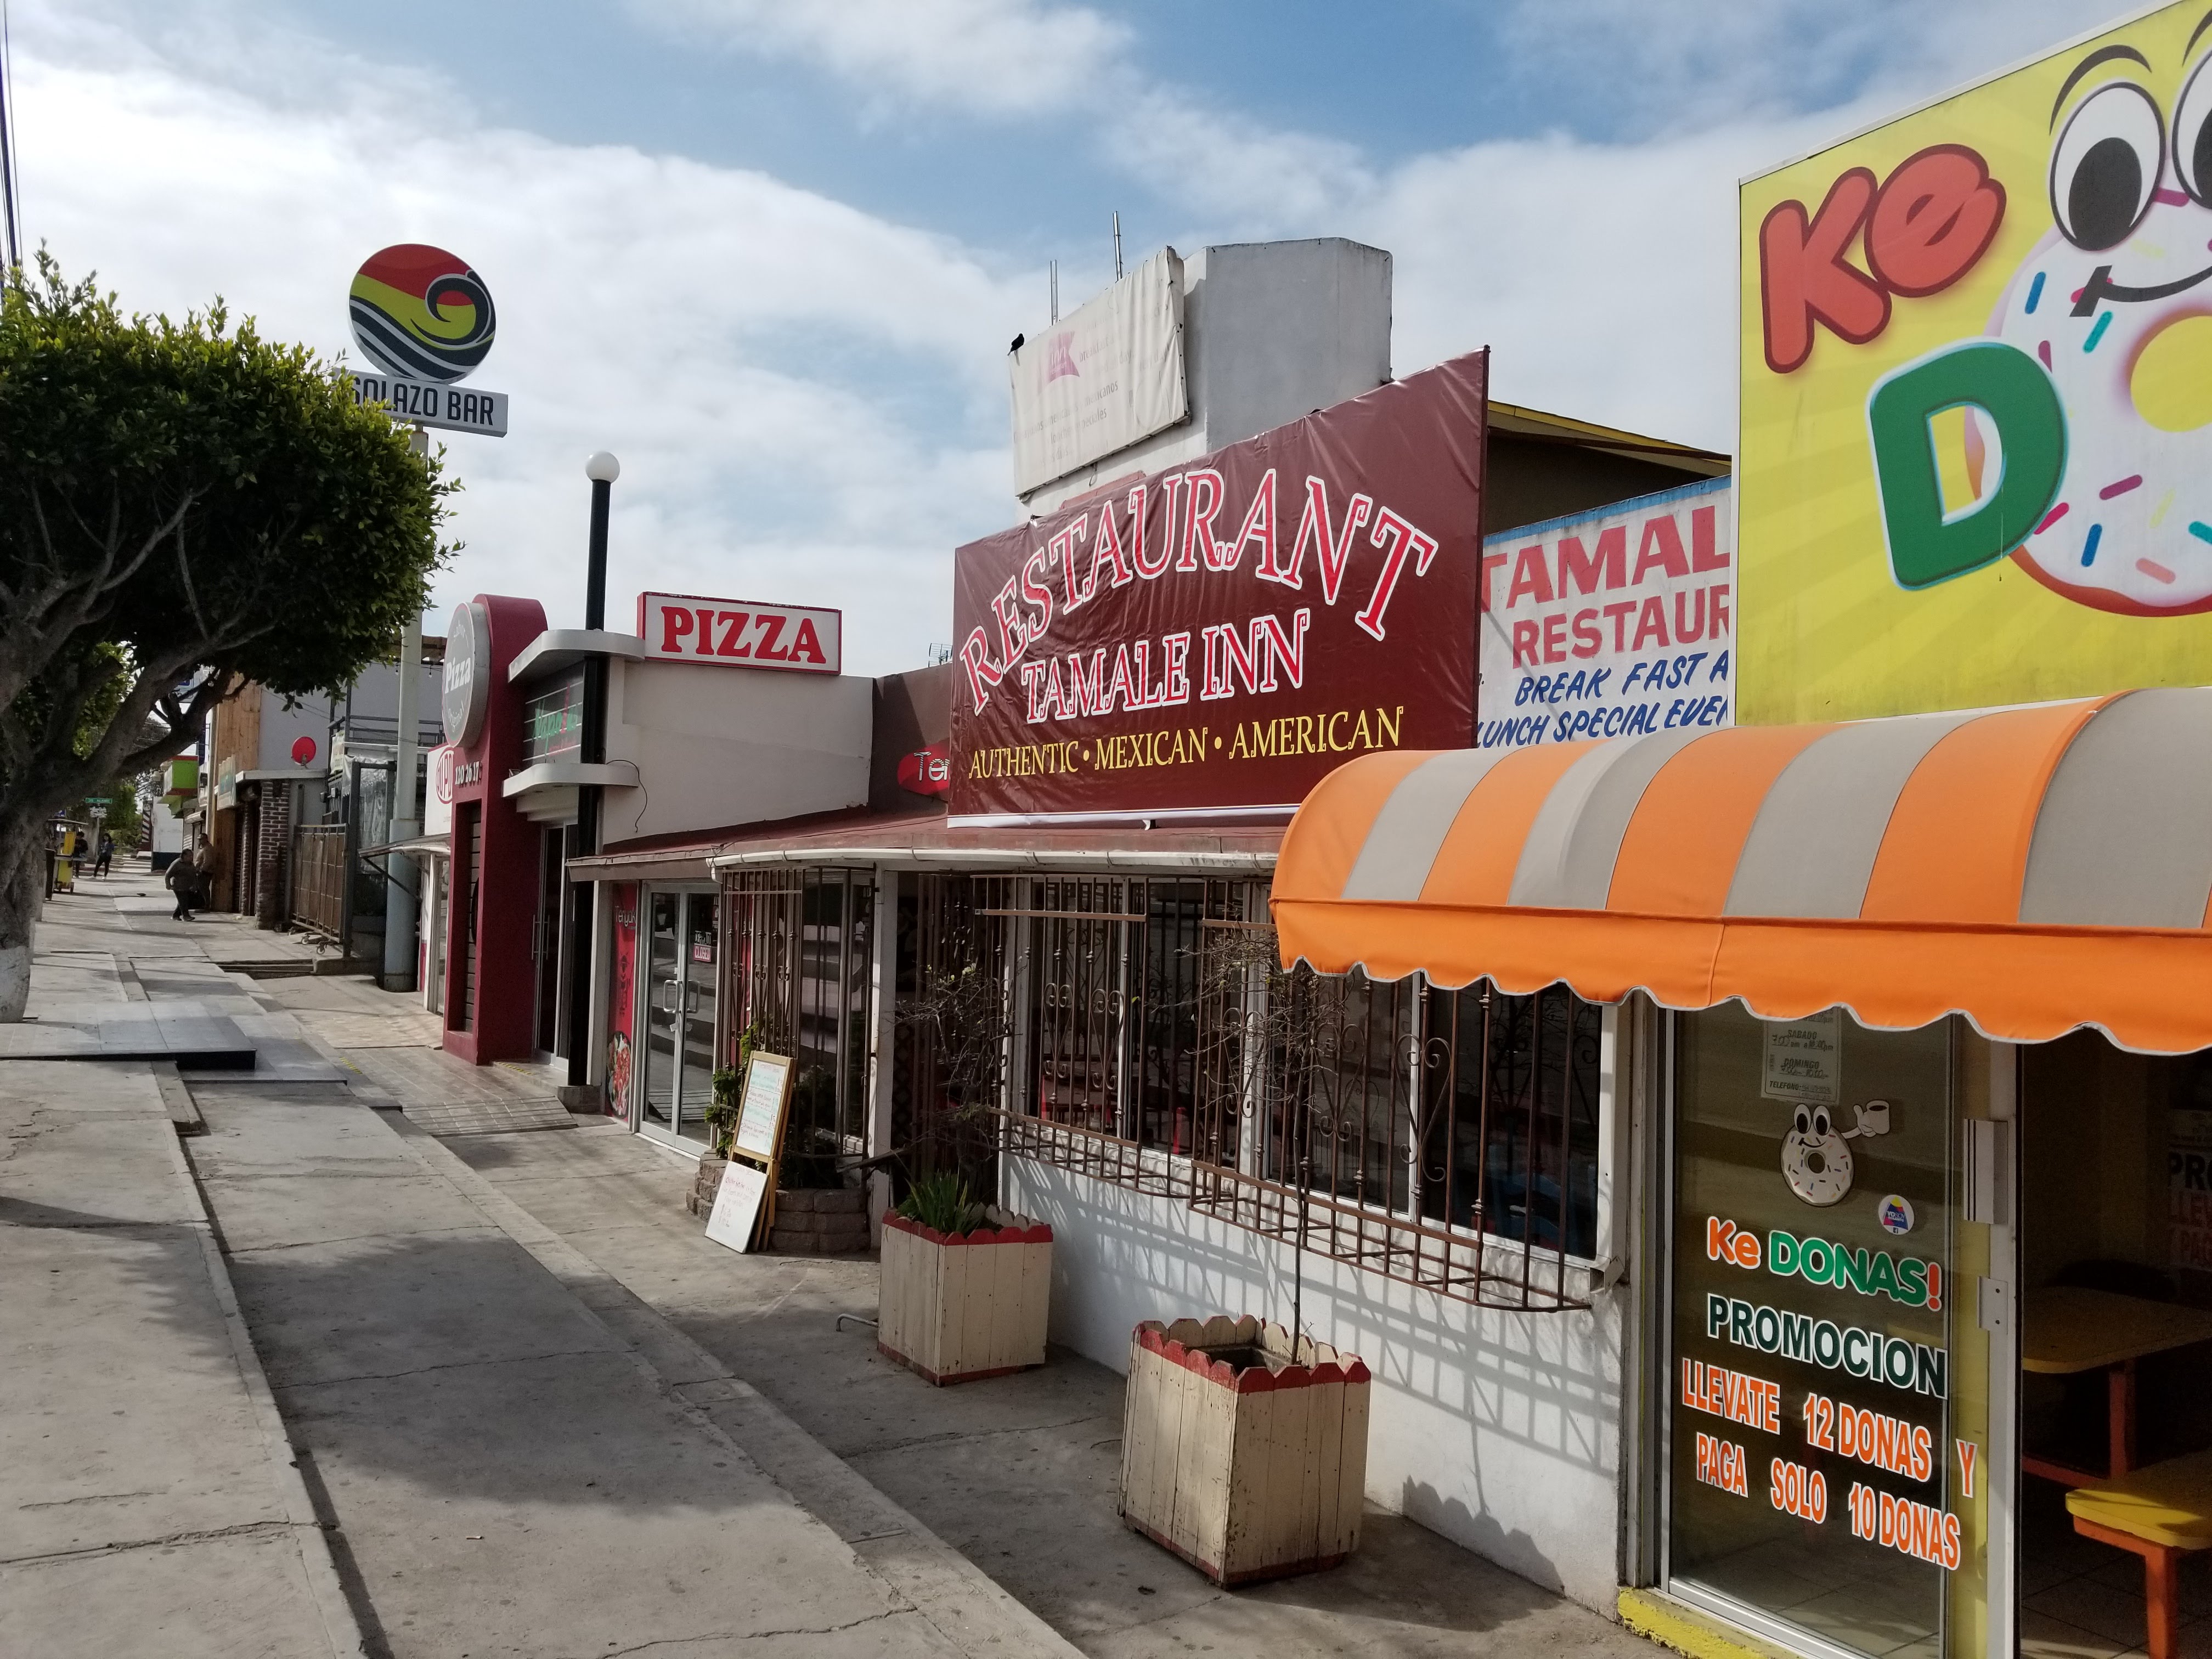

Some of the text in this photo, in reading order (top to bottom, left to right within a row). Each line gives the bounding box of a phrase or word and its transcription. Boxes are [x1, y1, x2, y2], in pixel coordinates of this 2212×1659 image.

[1759, 143, 2007, 374] Ke
[448, 390, 494, 426] BAR
[959, 469, 1438, 716] RESTAURANT
[444, 657, 471, 694] Pizza
[661, 606, 827, 664] PIZZA
[1021, 607, 1310, 724] TAMALE INN
[1515, 667, 1612, 707] BREAK
[1622, 652, 1708, 696] FAST
[1553, 702, 1661, 741] SPECIAL
[968, 706, 1404, 779] AUTHENTIC MEXICAN AMERICAN
[1784, 1058, 1820, 1070] DOMINGO
[1707, 1216, 1942, 1311] Ke DONAS!
[1707, 1293, 1948, 1400] PROMOCION
[1683, 1357, 1978, 1498] LLEVATE 12 DONAS Y
[1696, 1432, 1961, 1571] PAGA SOLO 10 DONAS
